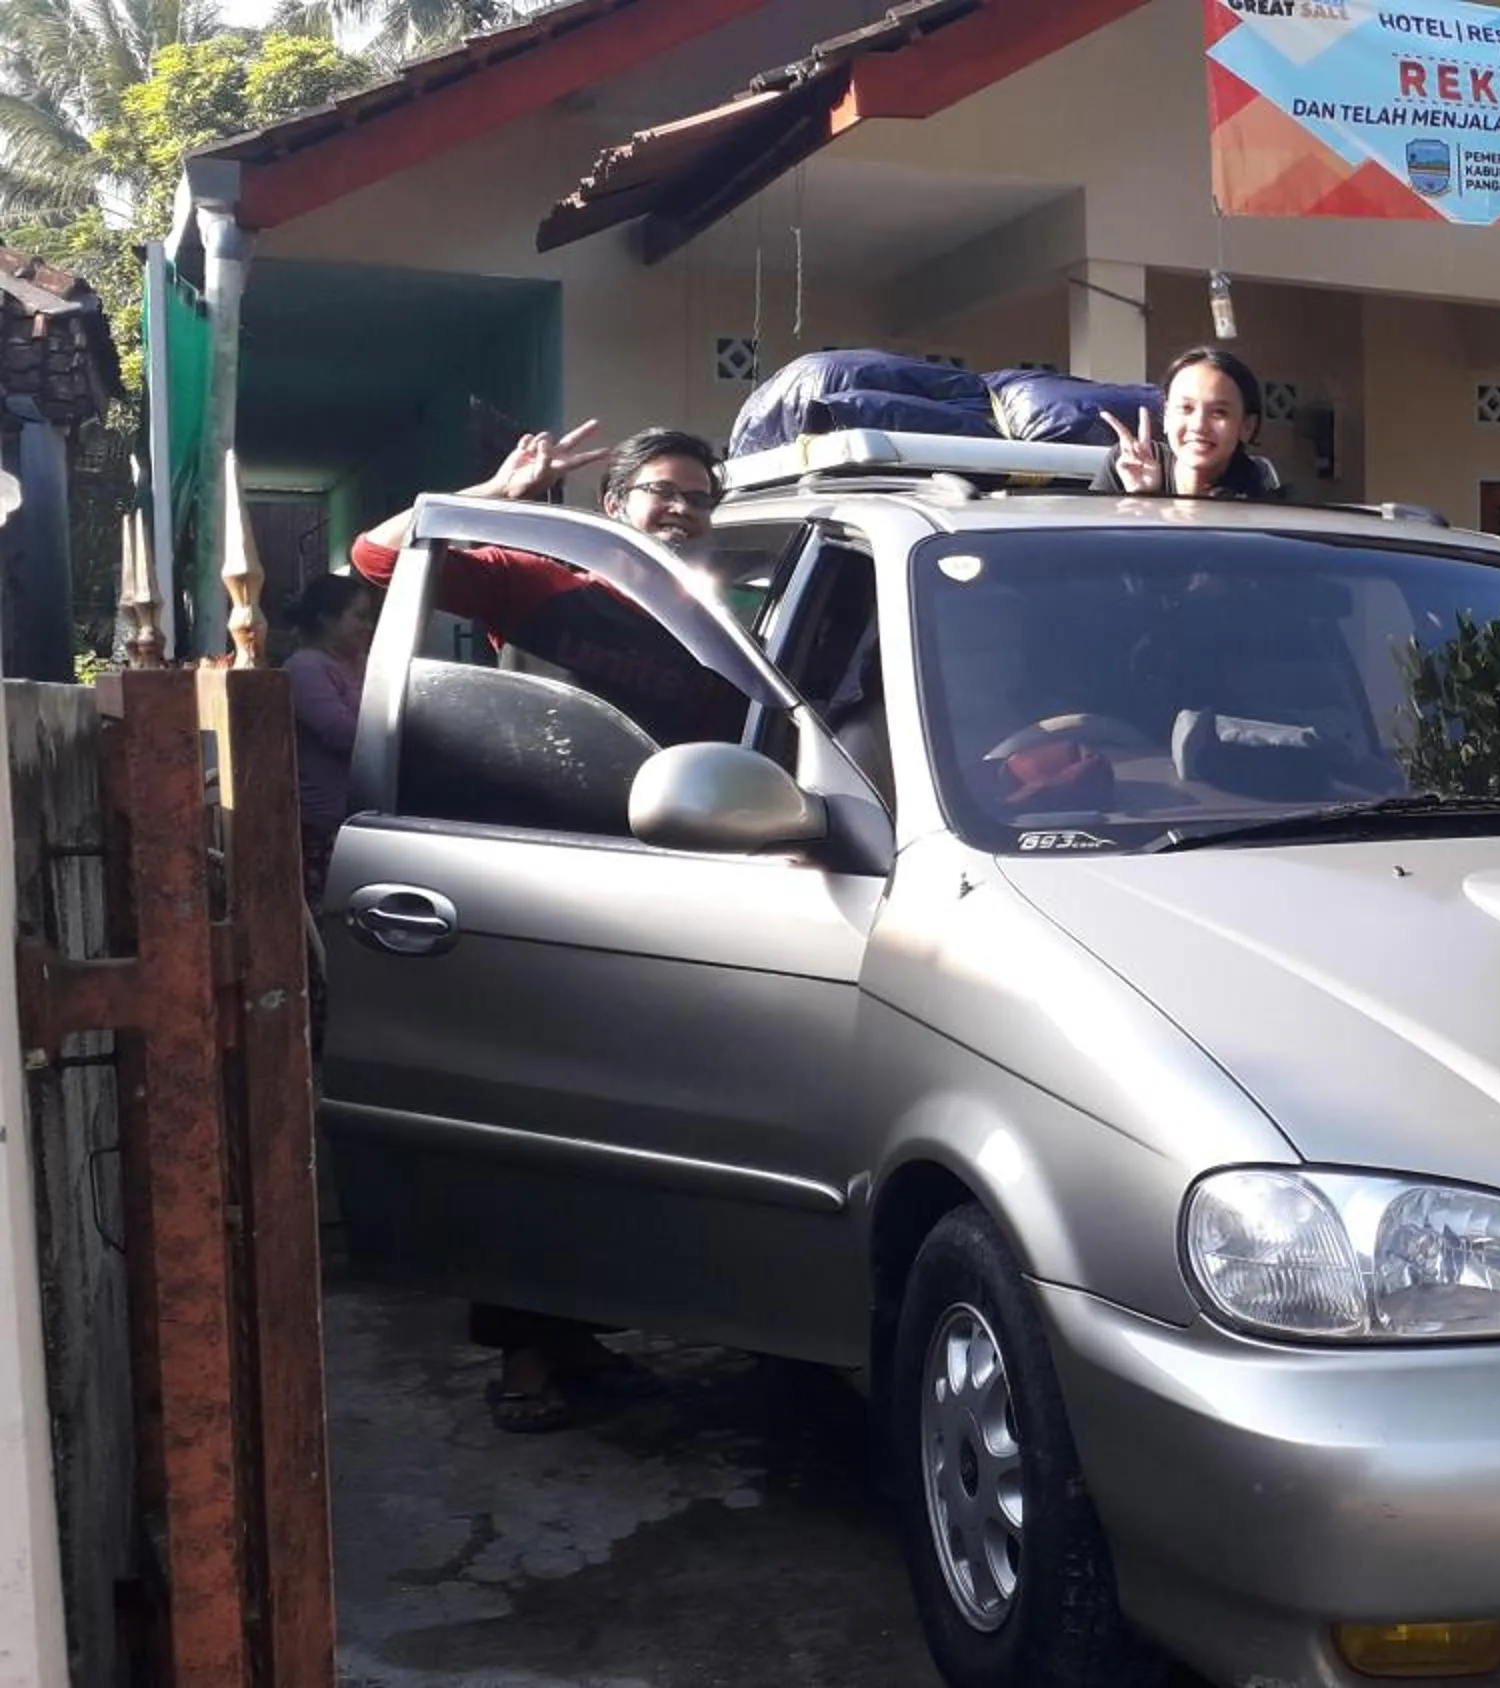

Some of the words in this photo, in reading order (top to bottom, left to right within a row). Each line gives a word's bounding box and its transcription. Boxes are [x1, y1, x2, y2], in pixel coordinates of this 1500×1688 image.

[1379, 13, 1452, 39] HOTEL
[1292, 98, 1335, 120] DAN
[1341, 103, 1407, 126] TELAH
